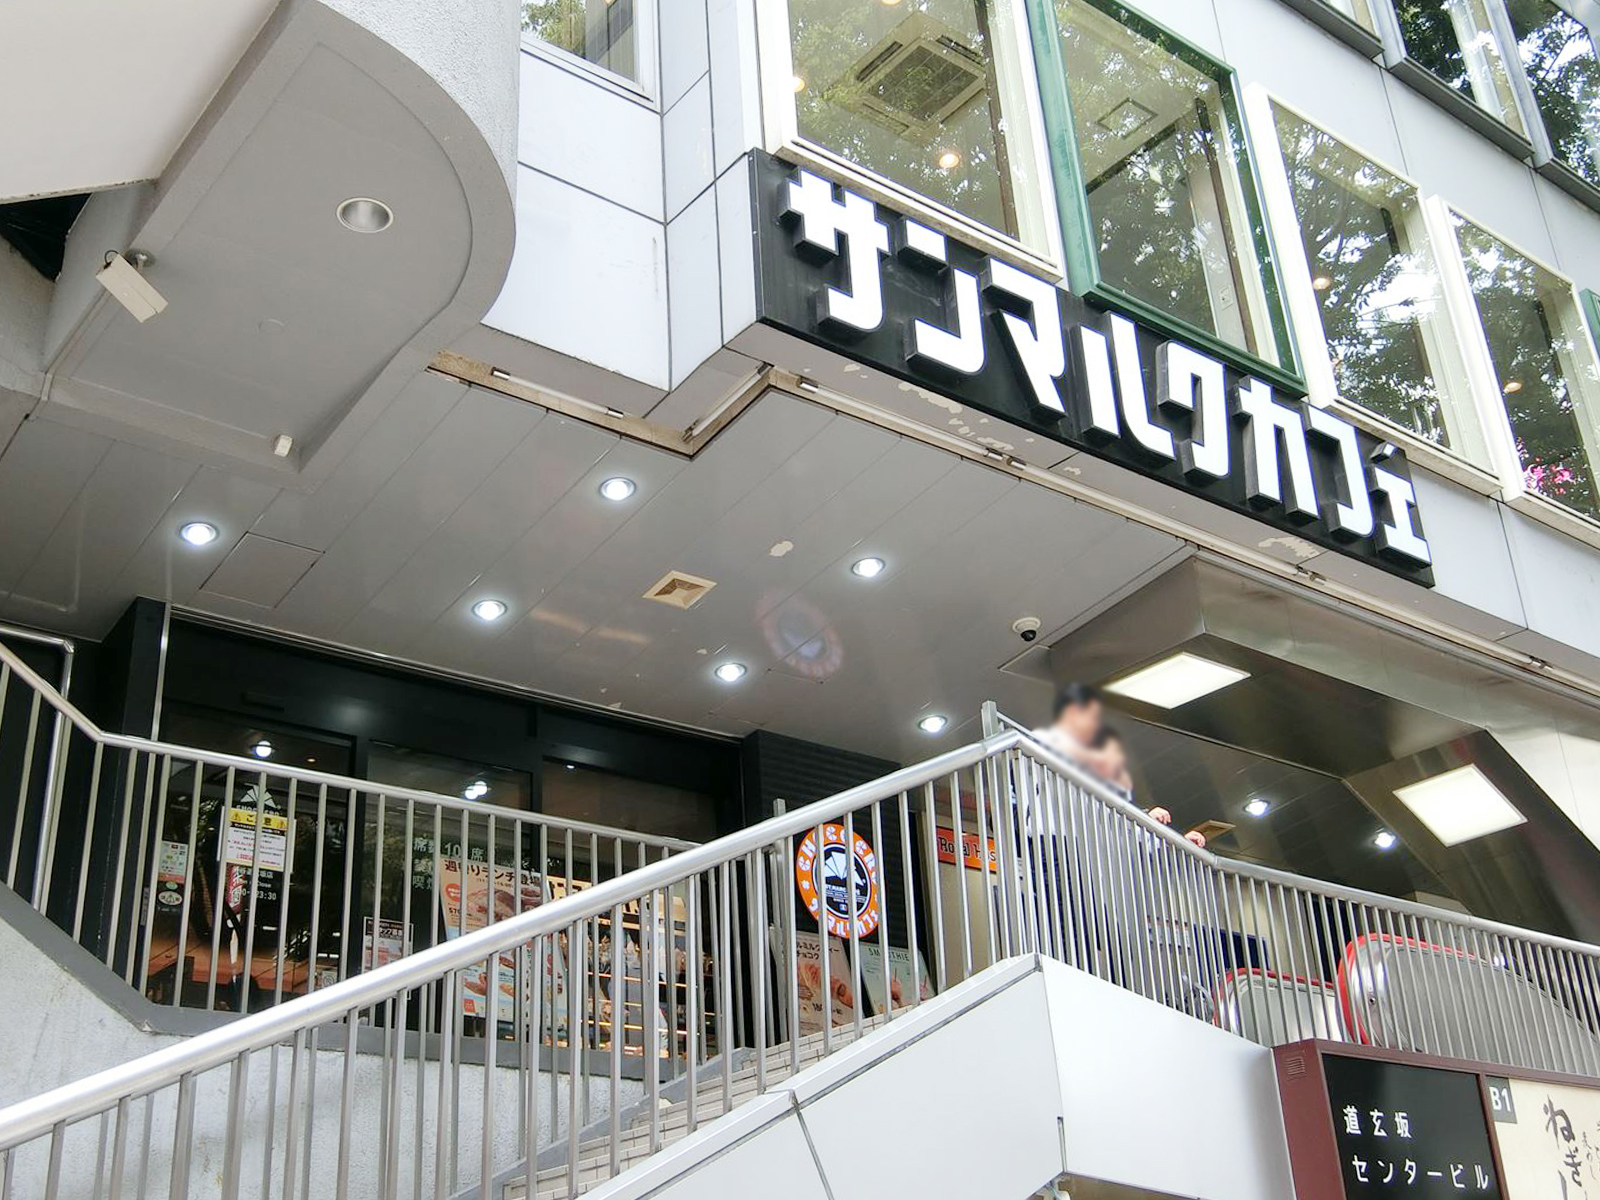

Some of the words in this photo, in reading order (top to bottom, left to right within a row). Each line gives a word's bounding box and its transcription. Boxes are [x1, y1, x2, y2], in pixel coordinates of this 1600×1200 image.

[786, 170, 1431, 566] サンマルクカフェ
[246, 814, 272, 826] ご意
[938, 836, 970, 856] Roal
[868, 947, 910, 962] SMTHIE
[1489, 1086, 1512, 1112] B1
[1342, 1105, 1413, 1139] 道玄坂
[1351, 1154, 1489, 1190] センタービル
